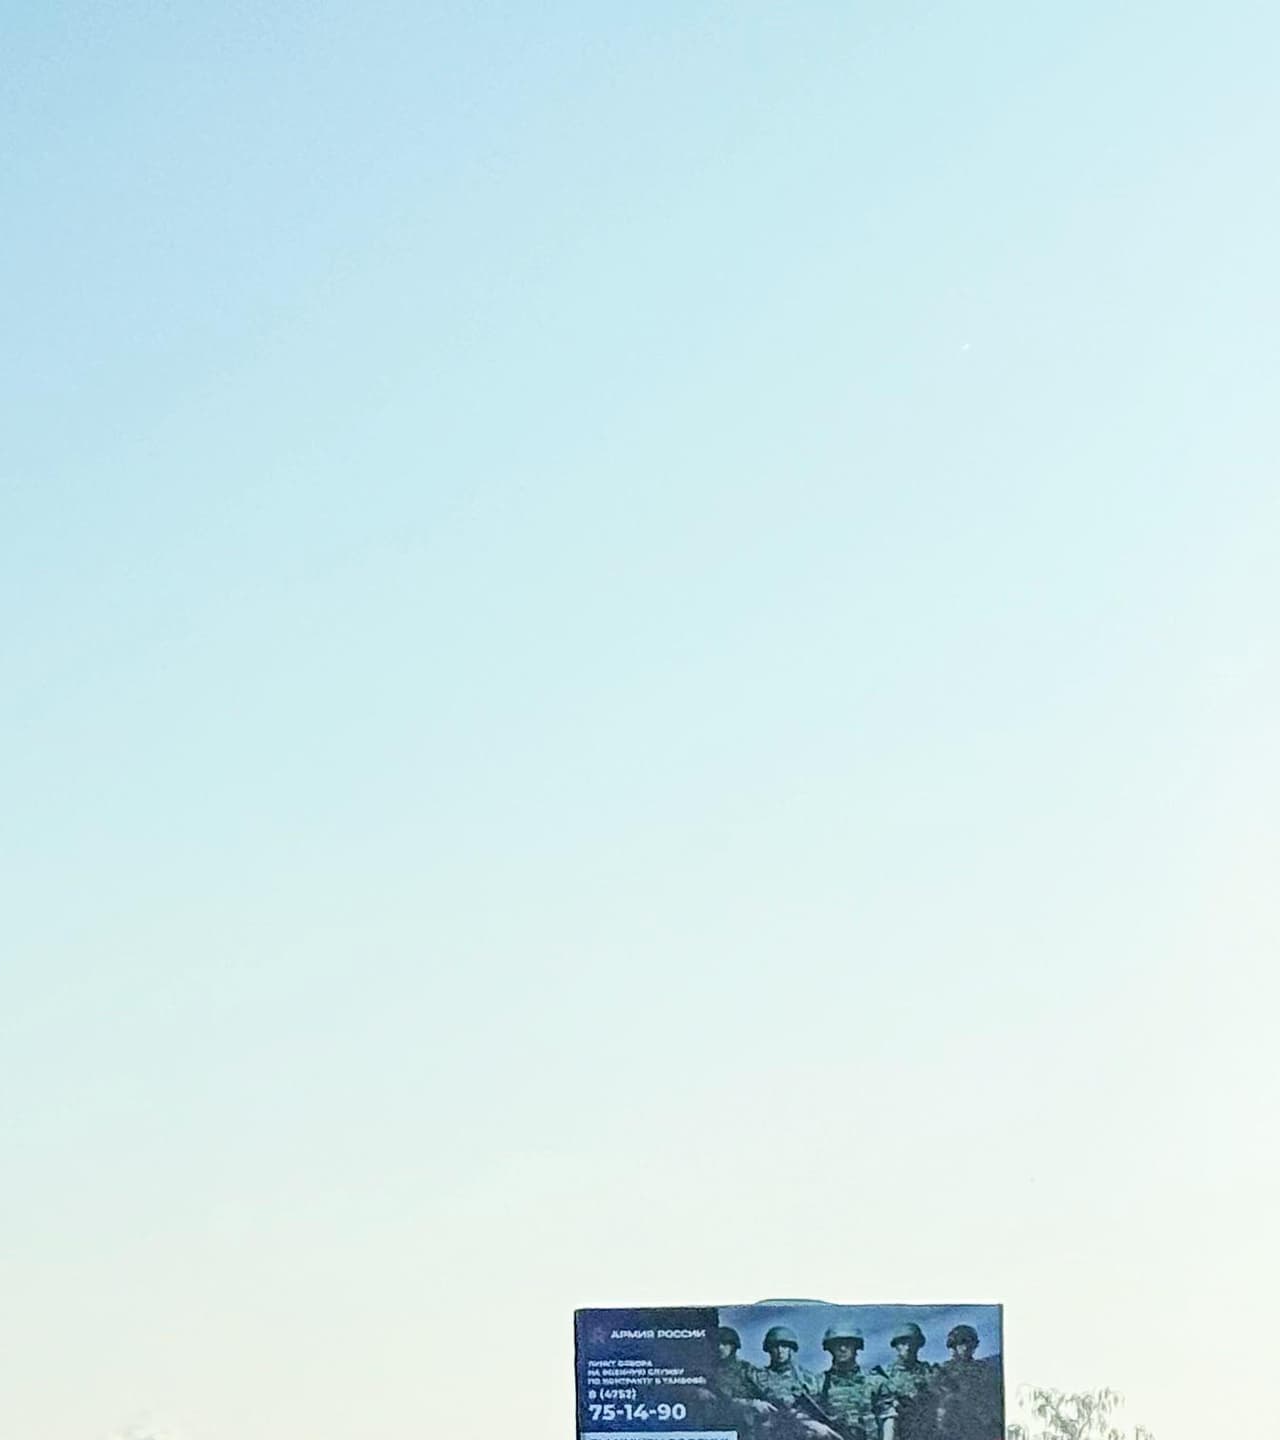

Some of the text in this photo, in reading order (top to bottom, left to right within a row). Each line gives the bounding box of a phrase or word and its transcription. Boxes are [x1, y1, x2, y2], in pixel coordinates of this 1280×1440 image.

[610, 1329, 707, 1339] АРМИЯ РОССИИ
[588, 1388, 637, 1401] 8 (4752)
[588, 1403, 687, 1421] 75-14-90
